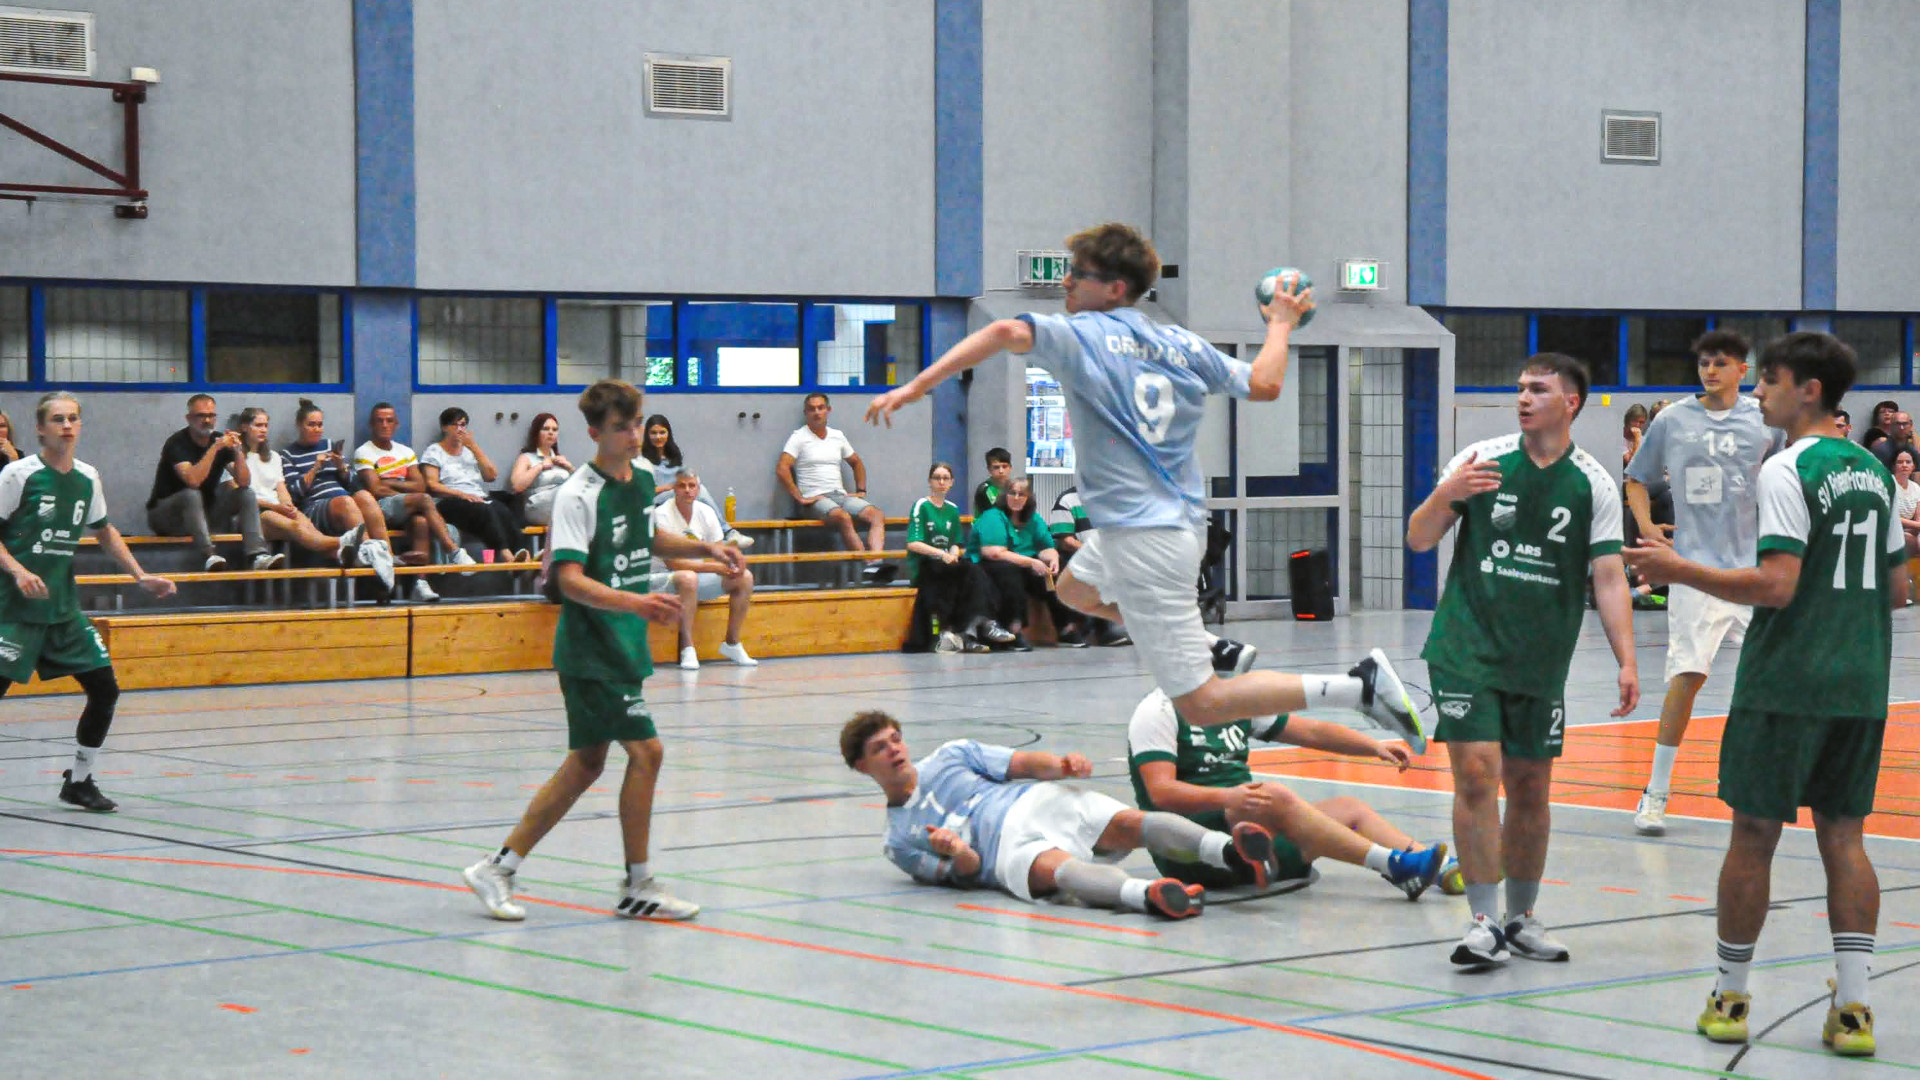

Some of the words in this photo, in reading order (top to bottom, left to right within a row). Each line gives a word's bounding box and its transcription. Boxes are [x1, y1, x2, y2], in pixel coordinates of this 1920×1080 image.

[1134, 372, 1176, 445] 9
[1703, 430, 1738, 456] 14
[72, 499, 86, 526] 6
[1547, 506, 1572, 543] 2
[1514, 543, 1541, 557] ARS
[1832, 509, 1878, 590] 11
[1549, 707, 1563, 736] 2
[1217, 724, 1247, 752] 10
